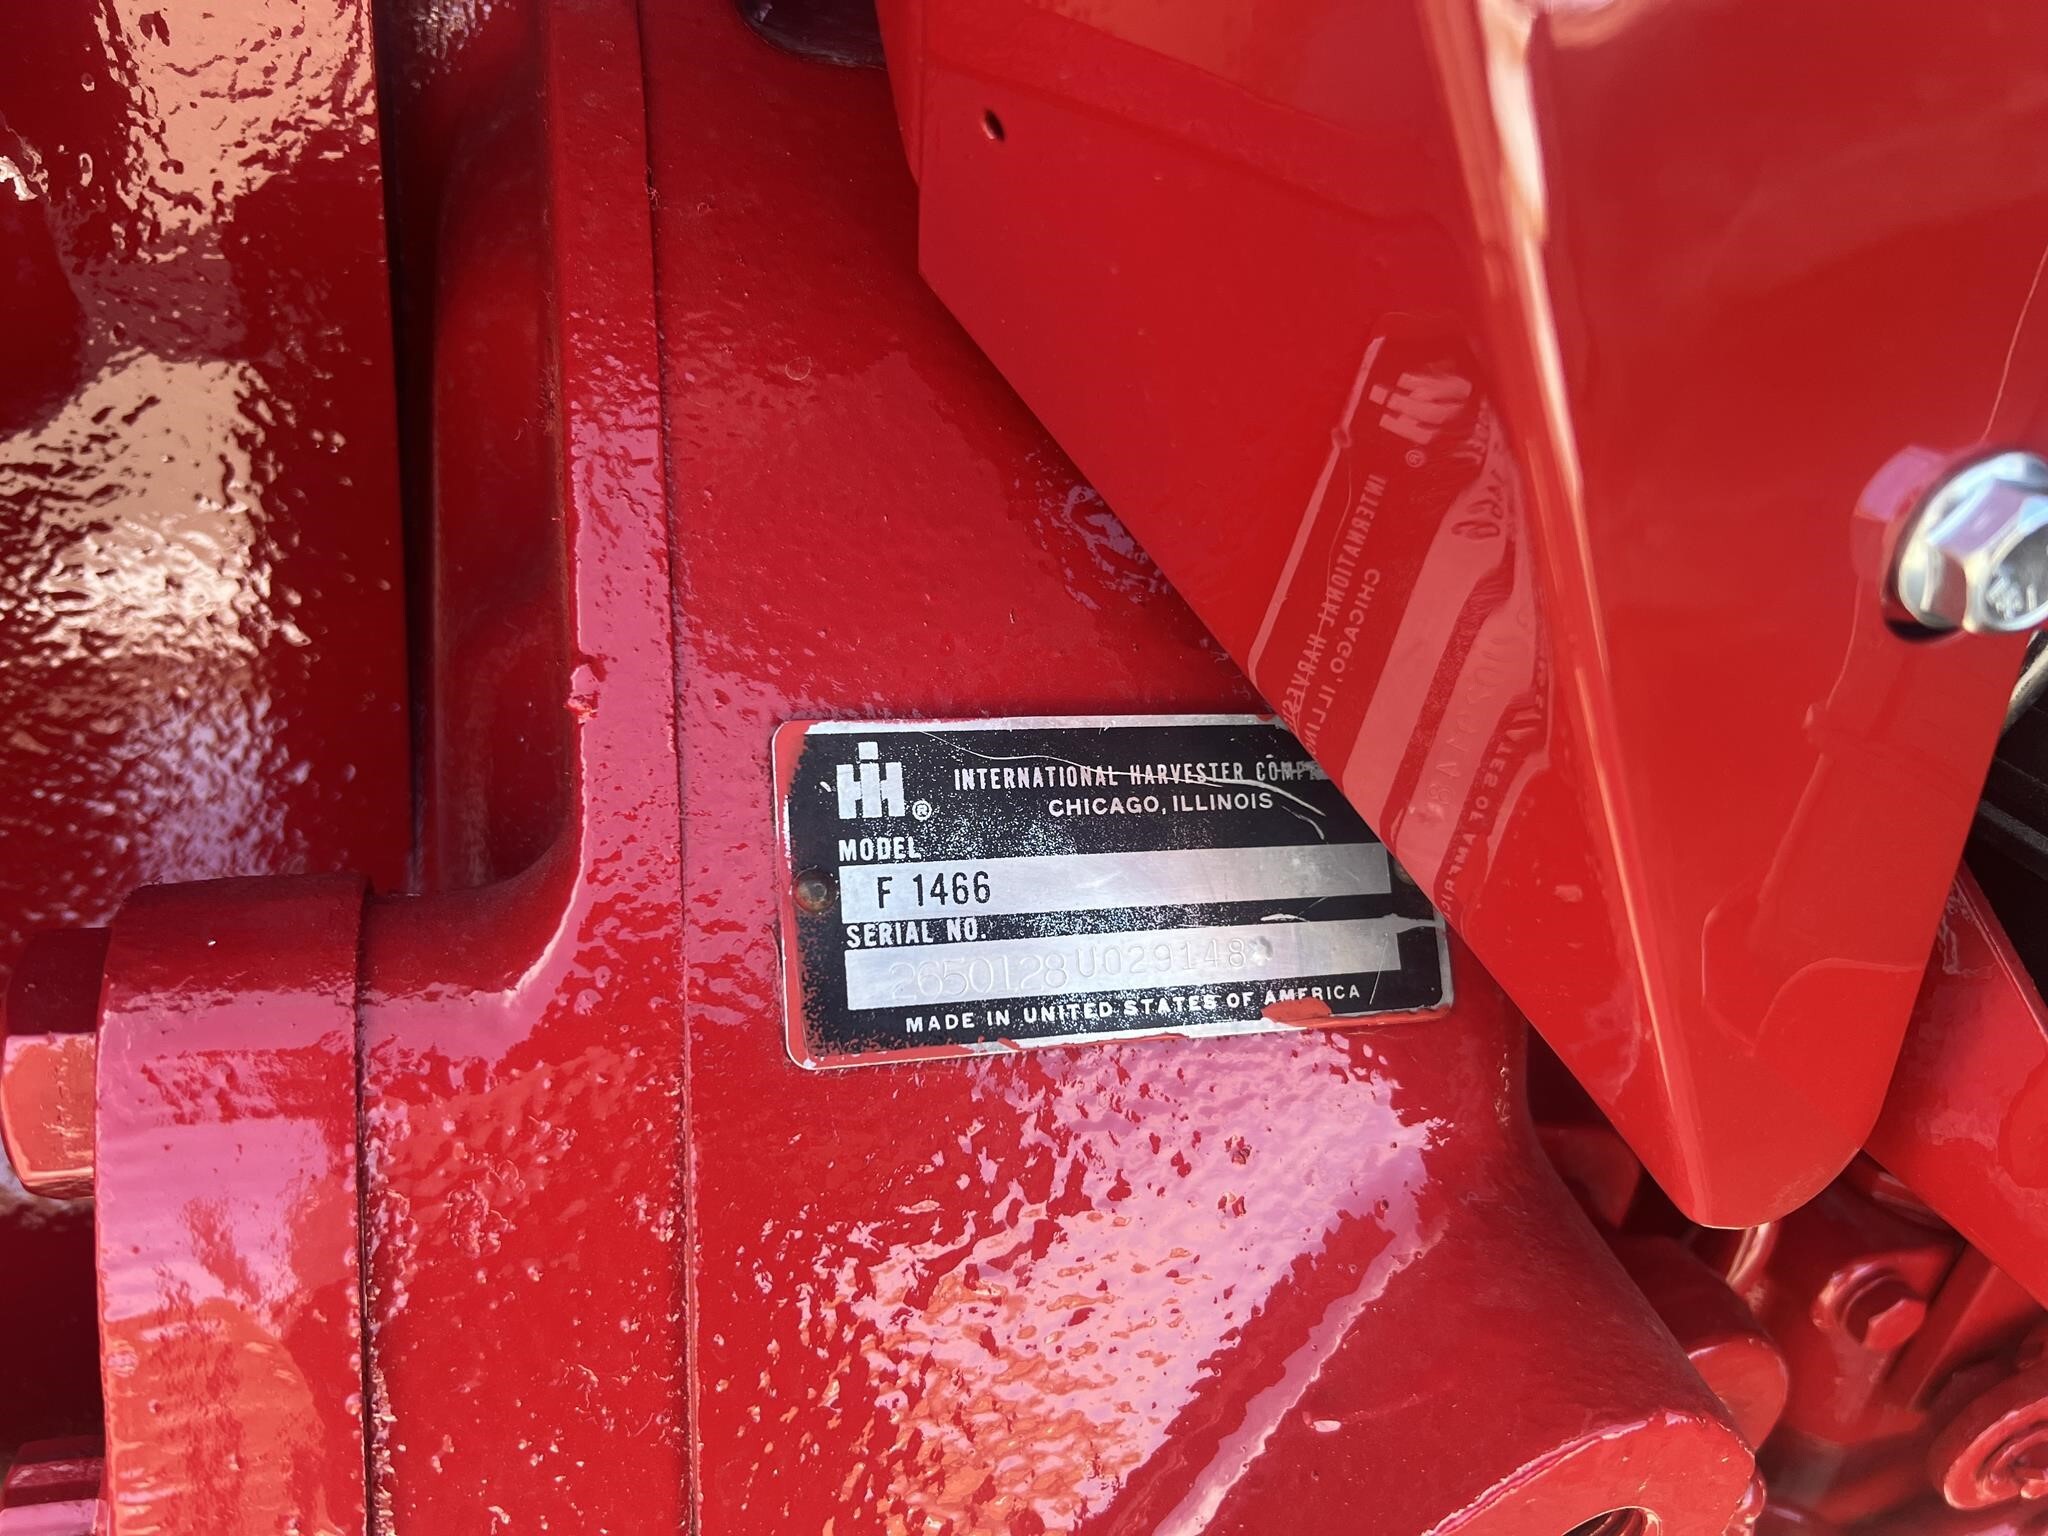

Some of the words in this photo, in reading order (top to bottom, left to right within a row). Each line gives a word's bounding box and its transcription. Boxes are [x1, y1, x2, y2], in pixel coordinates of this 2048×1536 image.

[953, 764, 1119, 791] INTERNATIONAL
[1129, 761, 1245, 786] HARVESTER
[1048, 792, 1167, 818] CHICAGO,
[1173, 792, 1274, 813] ILLINOIS
[838, 837, 922, 863] MODEL
[876, 875, 893, 909] F
[912, 870, 991, 907] 1466
[846, 921, 934, 949] SERIAL
[946, 918, 987, 943] NO.
[905, 1012, 976, 1033] MADE
[987, 1009, 1011, 1026] IN
[1023, 1001, 1113, 1024] UNITED
[1123, 994, 1217, 1017] STATES
[1226, 992, 1250, 1009] OF
[1263, 983, 1361, 1006] AMERICA
